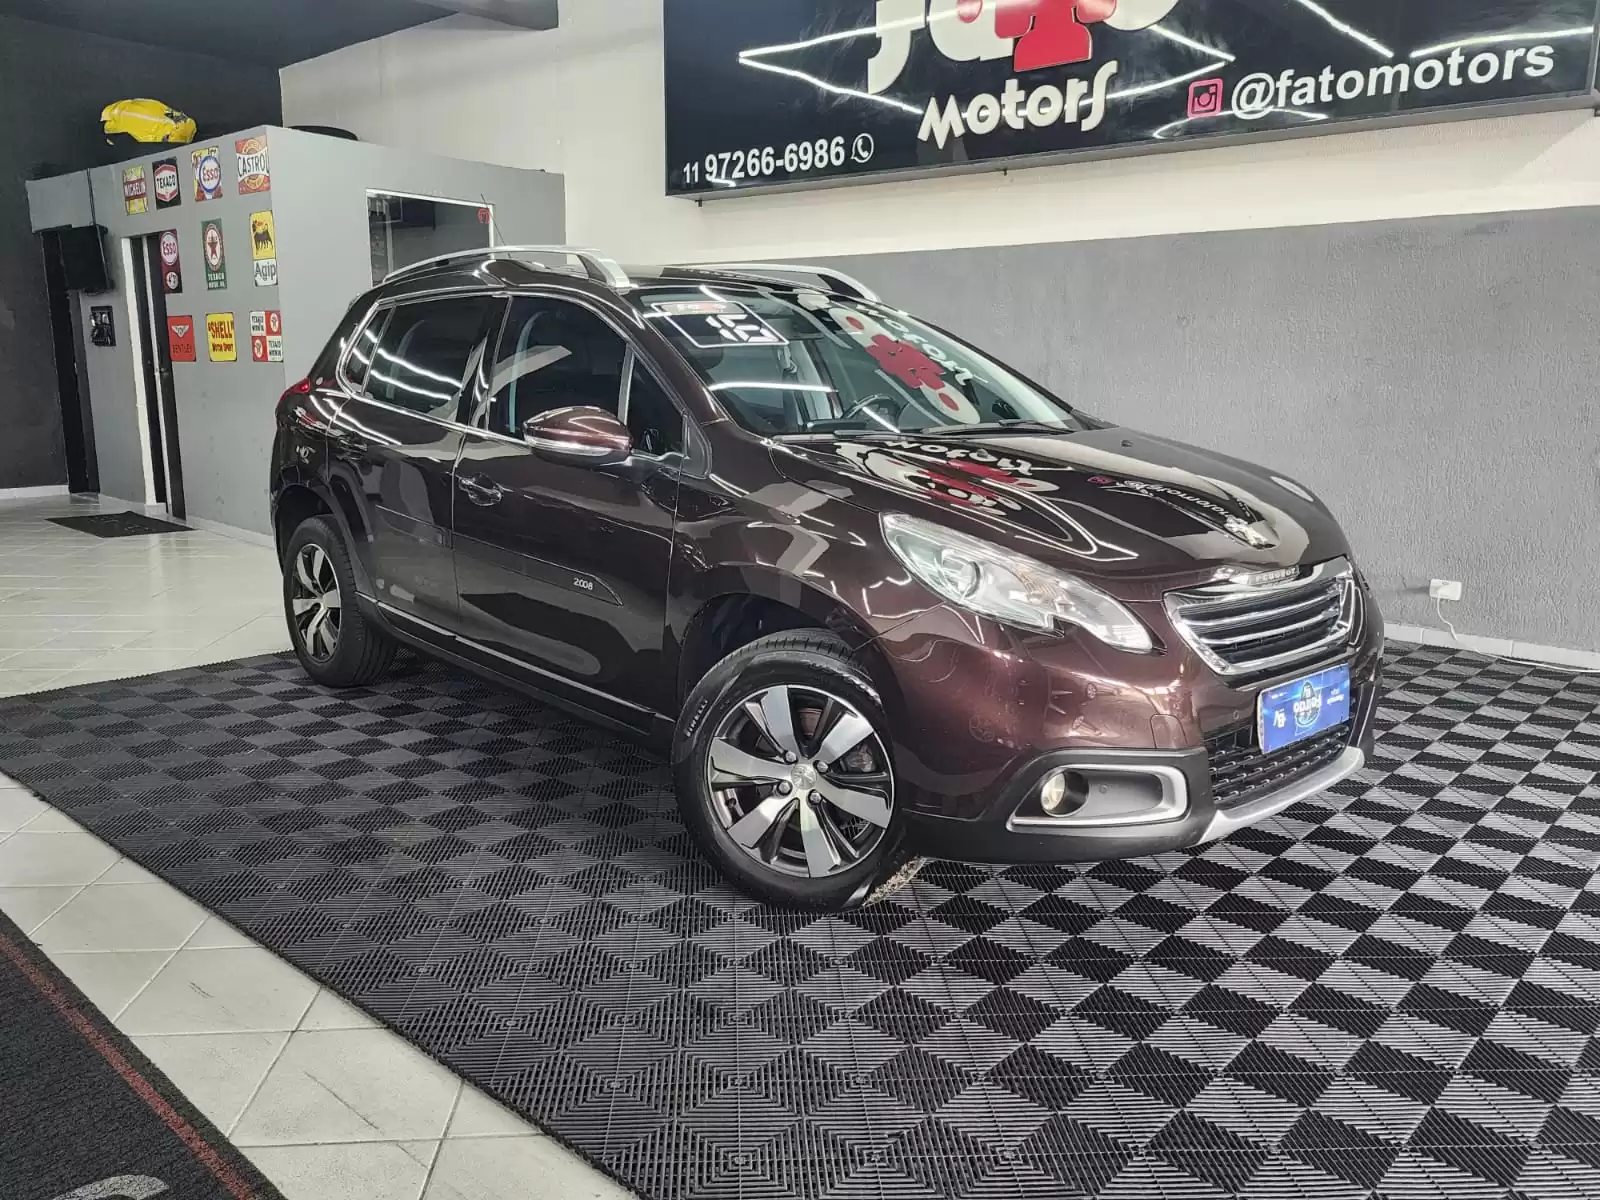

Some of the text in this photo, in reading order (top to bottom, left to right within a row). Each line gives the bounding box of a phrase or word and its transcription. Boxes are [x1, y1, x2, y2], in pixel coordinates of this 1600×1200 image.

[1231, 44, 1555, 120] @fatomotors
[237, 150, 270, 177] CASTROL
[683, 136, 846, 184] 11 97266-6986
[254, 262, 277, 281] Agip
[573, 577, 594, 590] 2008
